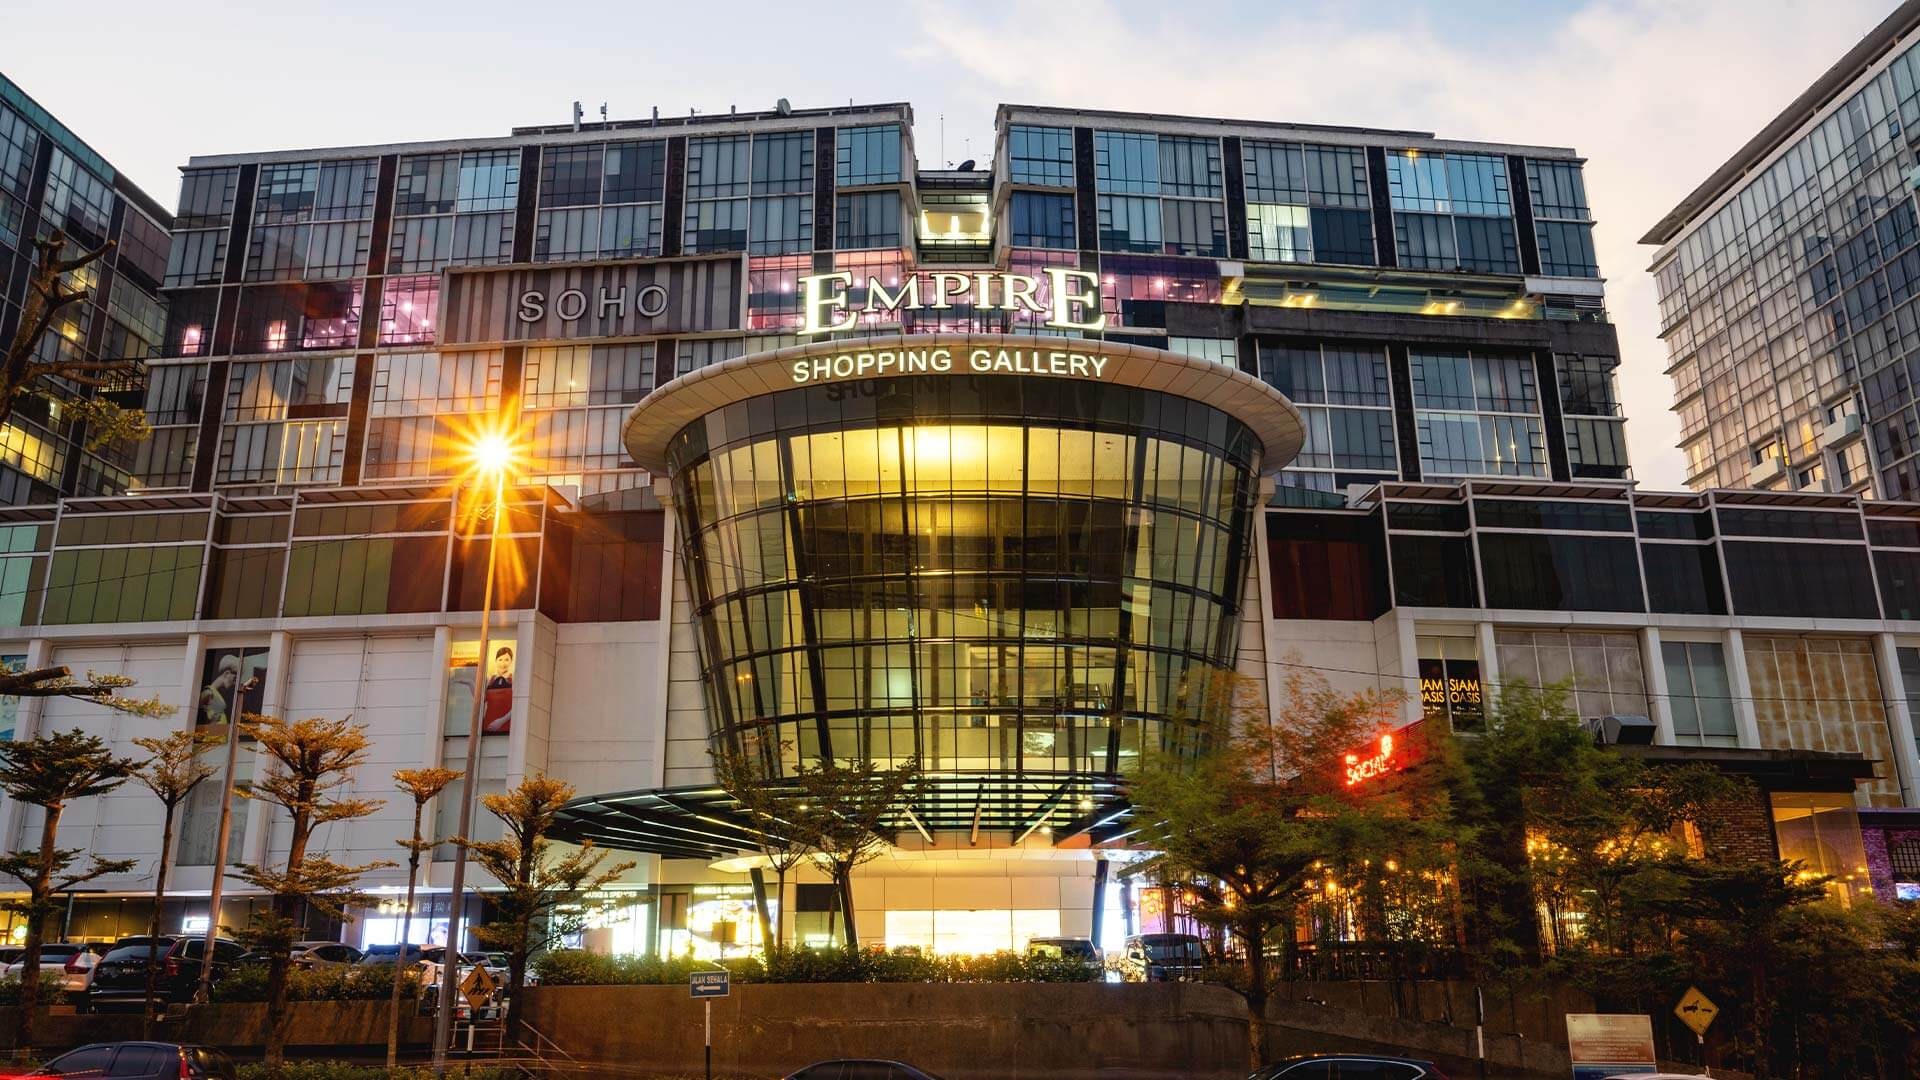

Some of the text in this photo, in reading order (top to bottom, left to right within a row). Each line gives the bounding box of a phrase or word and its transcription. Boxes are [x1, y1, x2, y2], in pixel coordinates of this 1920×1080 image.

[518, 284, 668, 323] SOHO
[797, 268, 1106, 336] EMPIRE
[793, 350, 1107, 383] SHOPPING GALLERY
[1420, 679, 1444, 691] IAM
[1449, 679, 1479, 692] SIAM
[1450, 692, 1481, 703] OASIS
